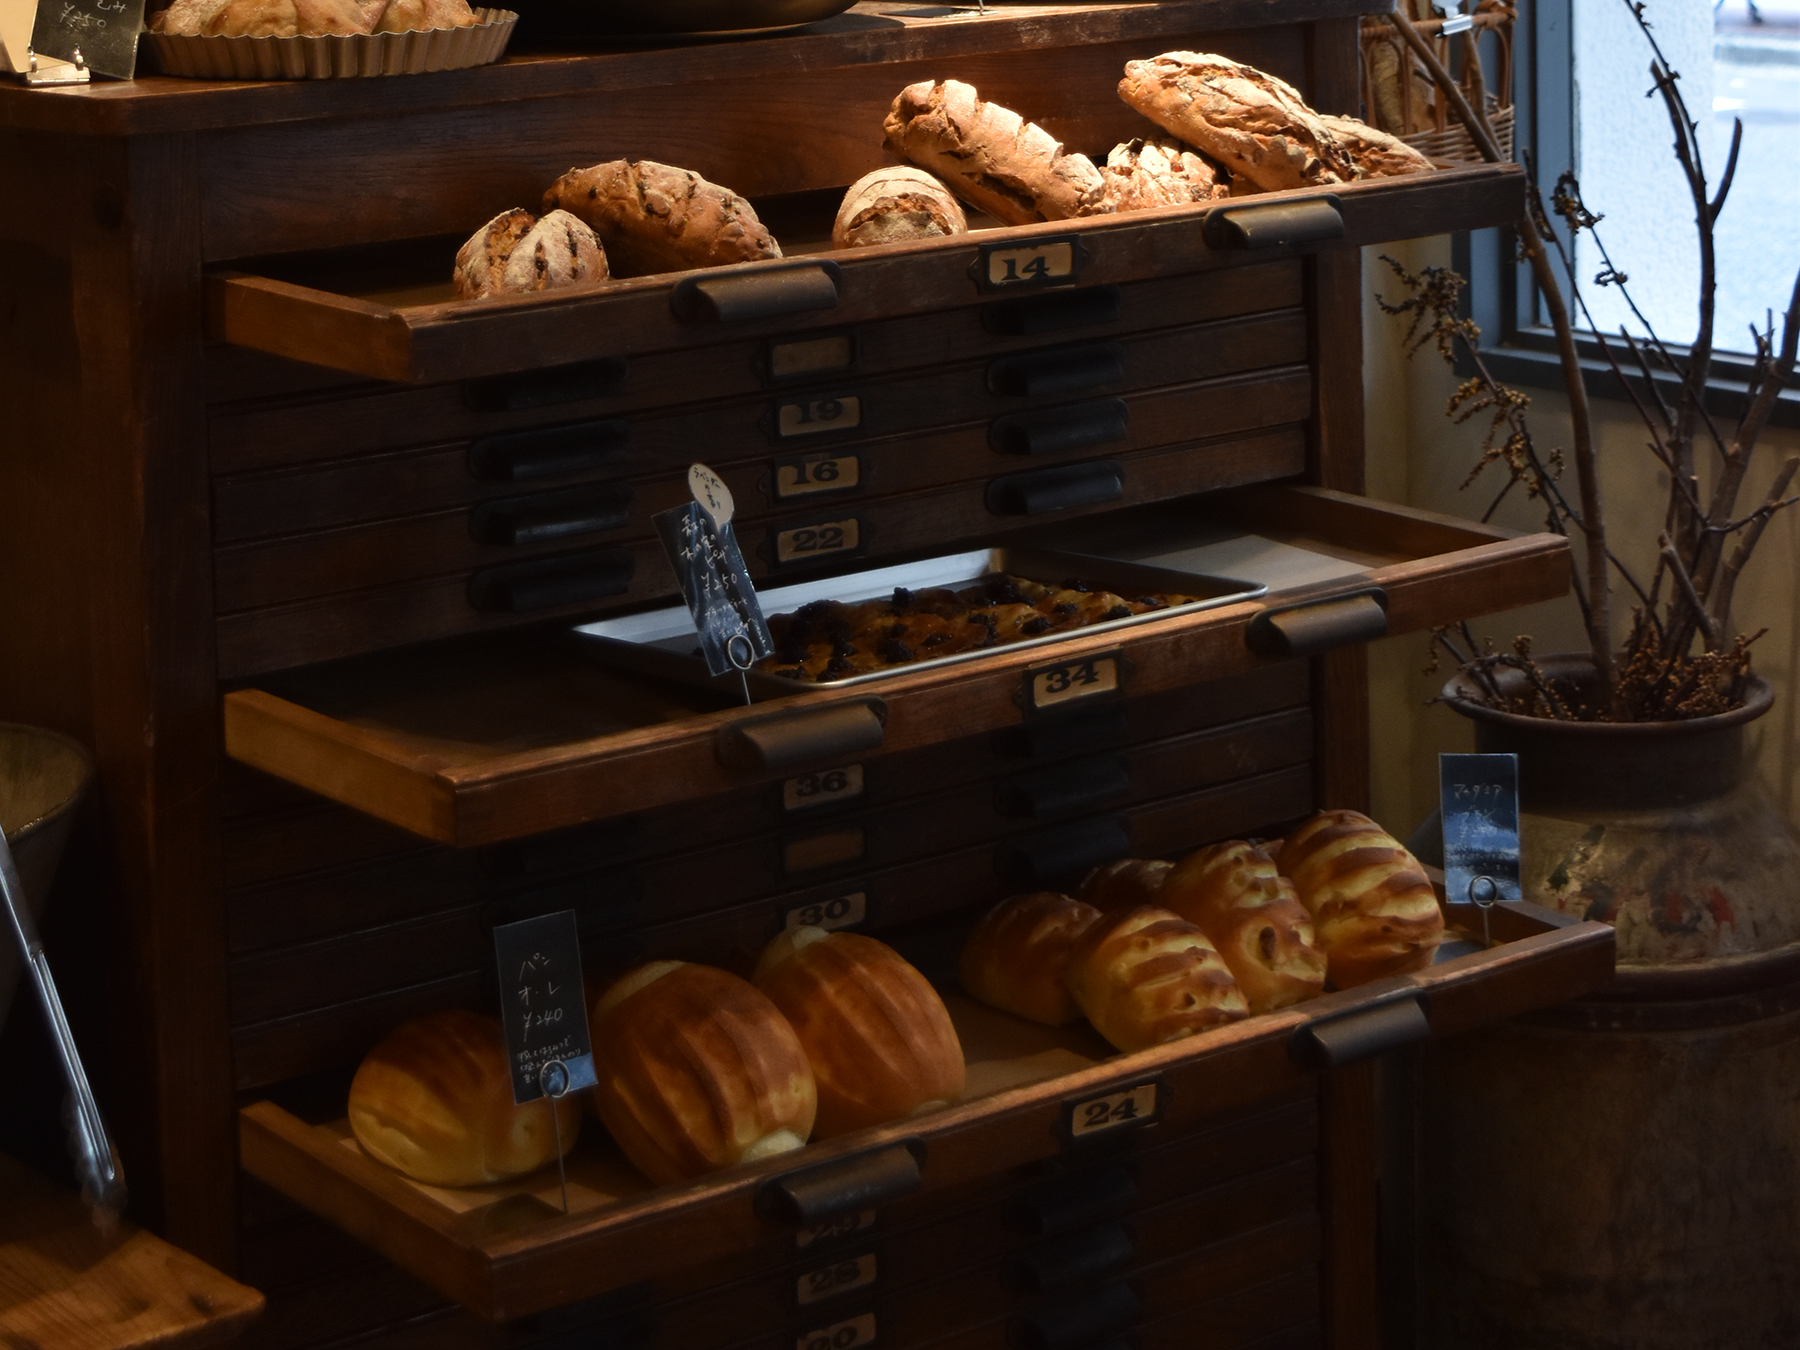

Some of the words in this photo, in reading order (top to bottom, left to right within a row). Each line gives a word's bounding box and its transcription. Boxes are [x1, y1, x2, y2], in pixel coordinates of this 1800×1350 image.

[1001, 256, 1050, 281] 14
[791, 460, 839, 486] 16
[792, 527, 843, 552] 22
[700, 572, 738, 599] ¥250
[1046, 662, 1100, 693] 34
[796, 771, 848, 797] 36
[799, 898, 851, 926] 30
[519, 952, 551, 982] パン
[523, 1008, 563, 1043] ¥240
[1083, 1097, 1138, 1127] 24
